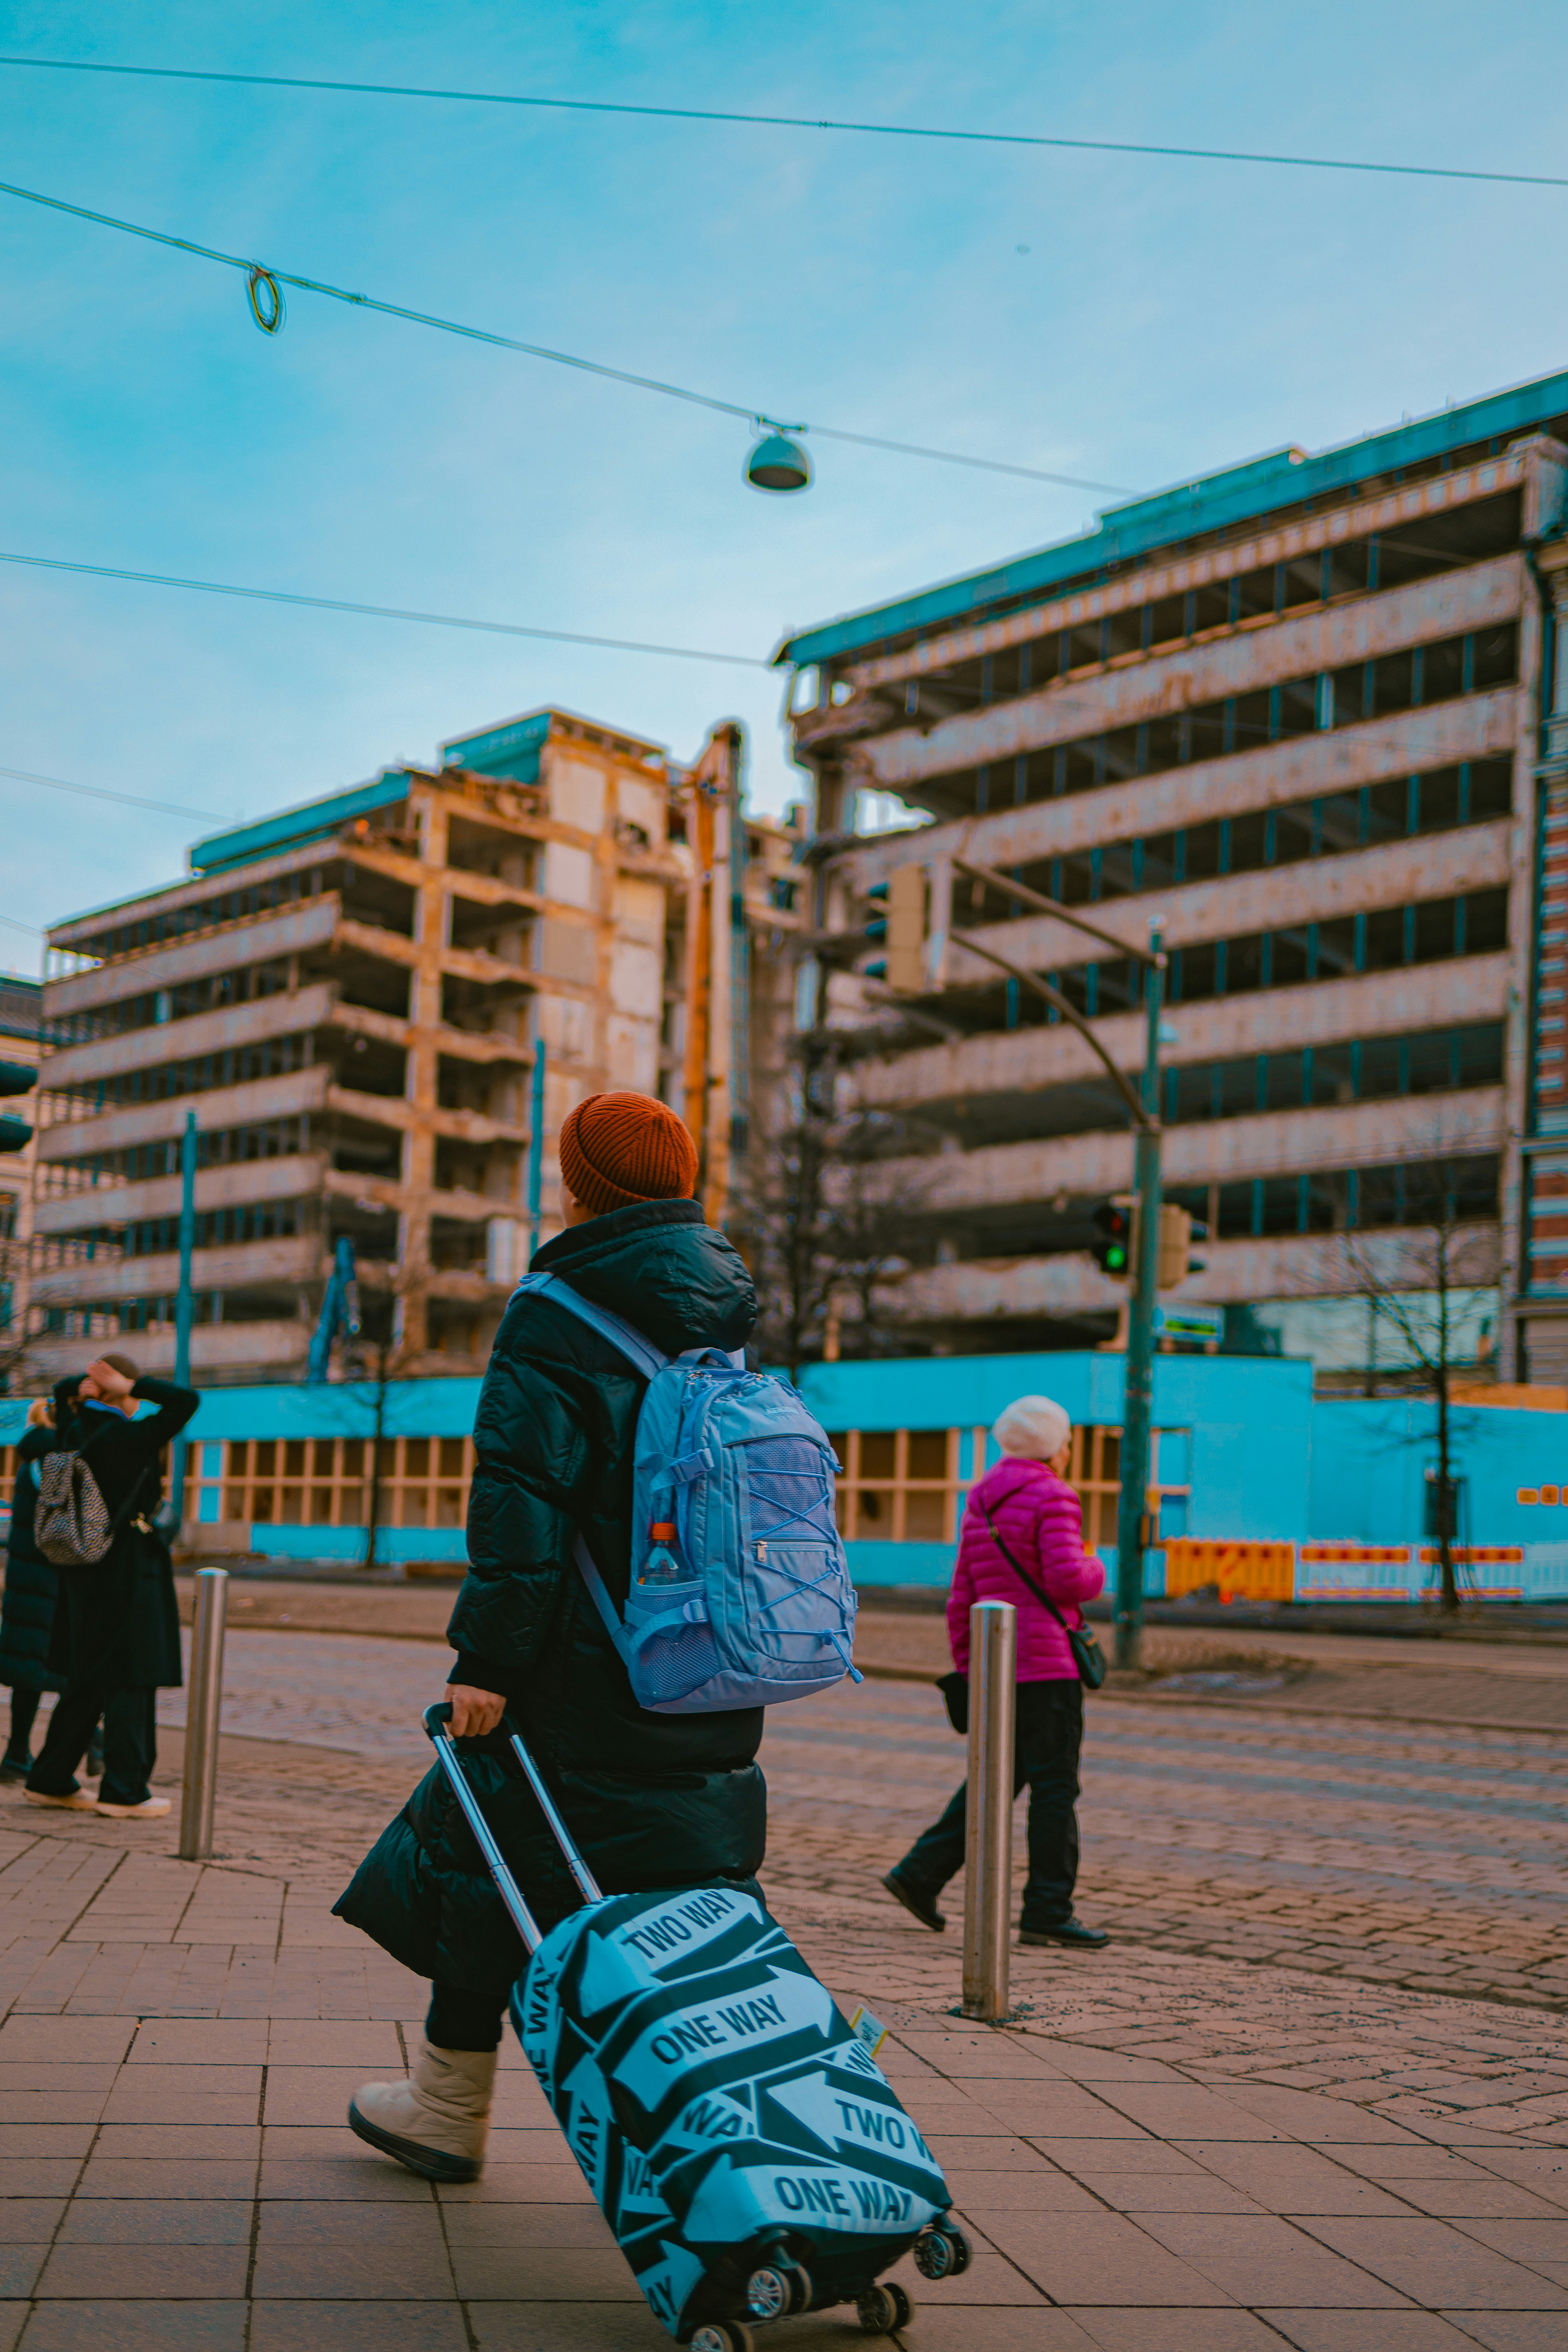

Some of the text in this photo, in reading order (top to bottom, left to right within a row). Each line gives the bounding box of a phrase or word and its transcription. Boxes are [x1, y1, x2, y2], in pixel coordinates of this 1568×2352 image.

[620, 1891, 736, 1959] TWO WAY
[651, 1994, 787, 2065] ONE WAY
[683, 2098, 755, 2139] WA
[834, 2098, 905, 2149] TWO
[774, 2176, 912, 2221] ONE WAY
